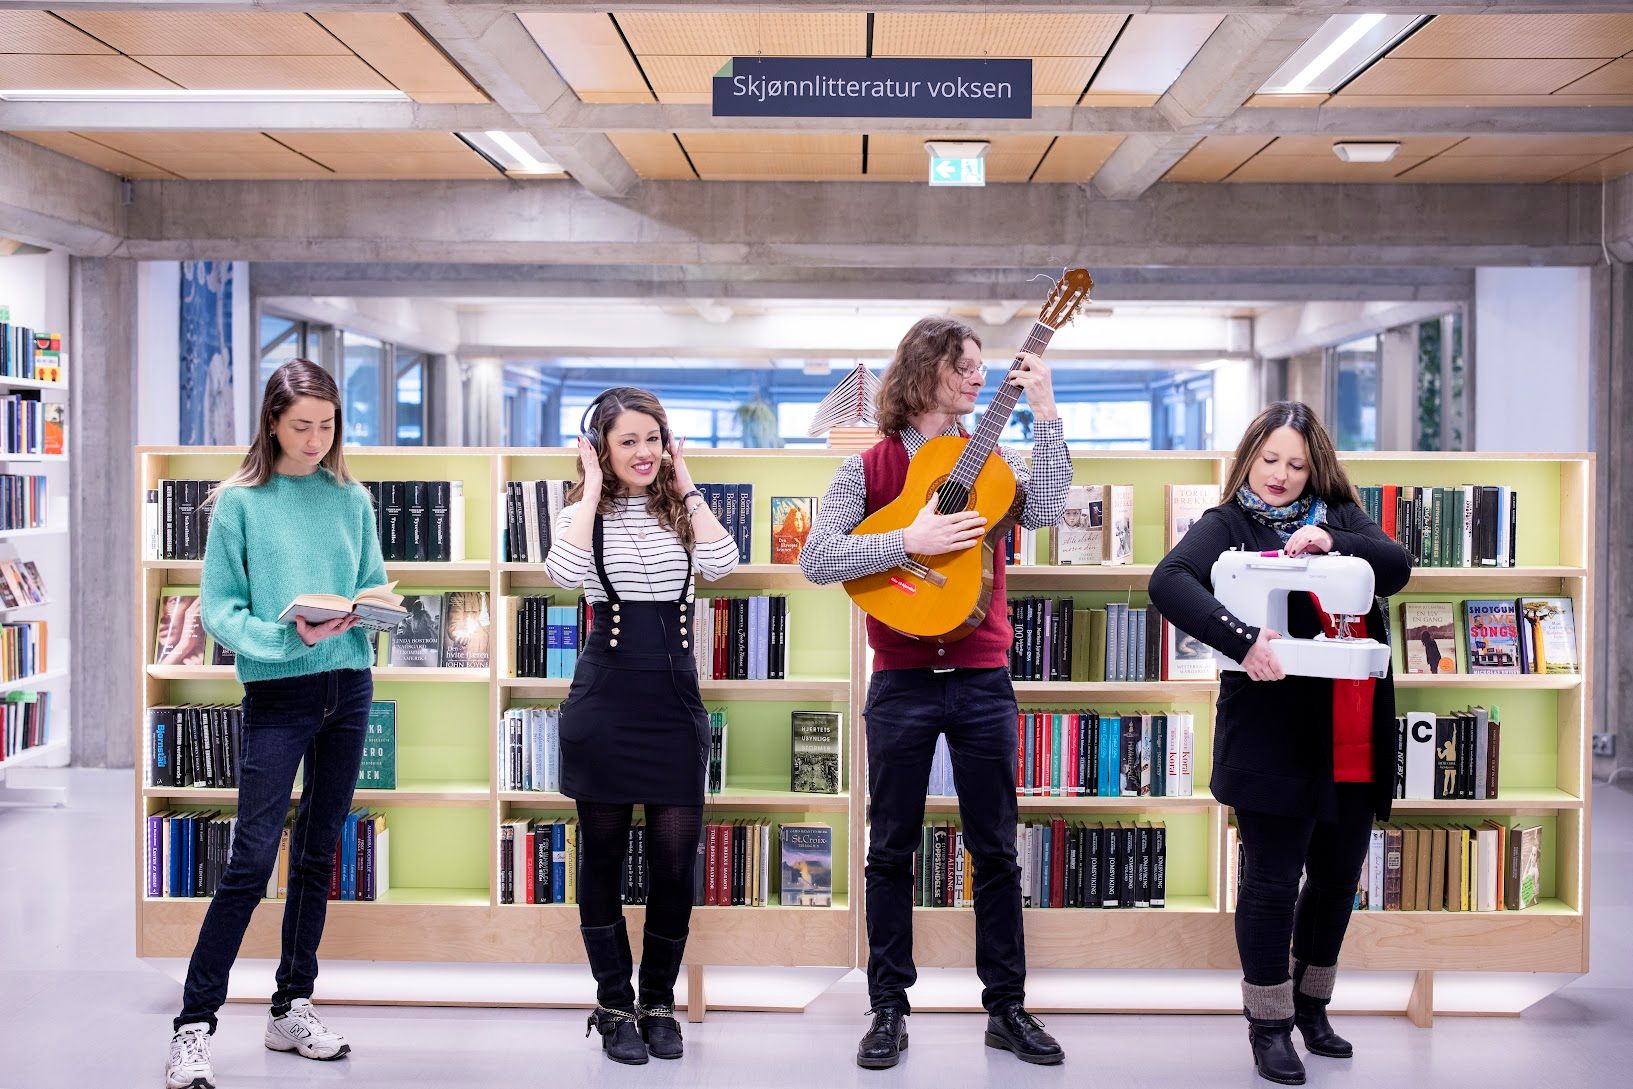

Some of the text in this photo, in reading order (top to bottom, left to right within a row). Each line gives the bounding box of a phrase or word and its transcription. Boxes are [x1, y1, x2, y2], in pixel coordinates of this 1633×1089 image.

[732, 75, 1012, 102] Skjønnlitteratur voksen
[740, 493, 748, 524] Bomann
[1470, 614, 1515, 626] LOVE
[1015, 624, 1024, 638] 100
[1471, 626, 1518, 638] SONGS
[1412, 720, 1432, 743] C
[1182, 752, 1190, 775] Koral
[1398, 764, 1404, 778] BY
[956, 834, 964, 900] TAUET
[290, 1024, 304, 1038] N
